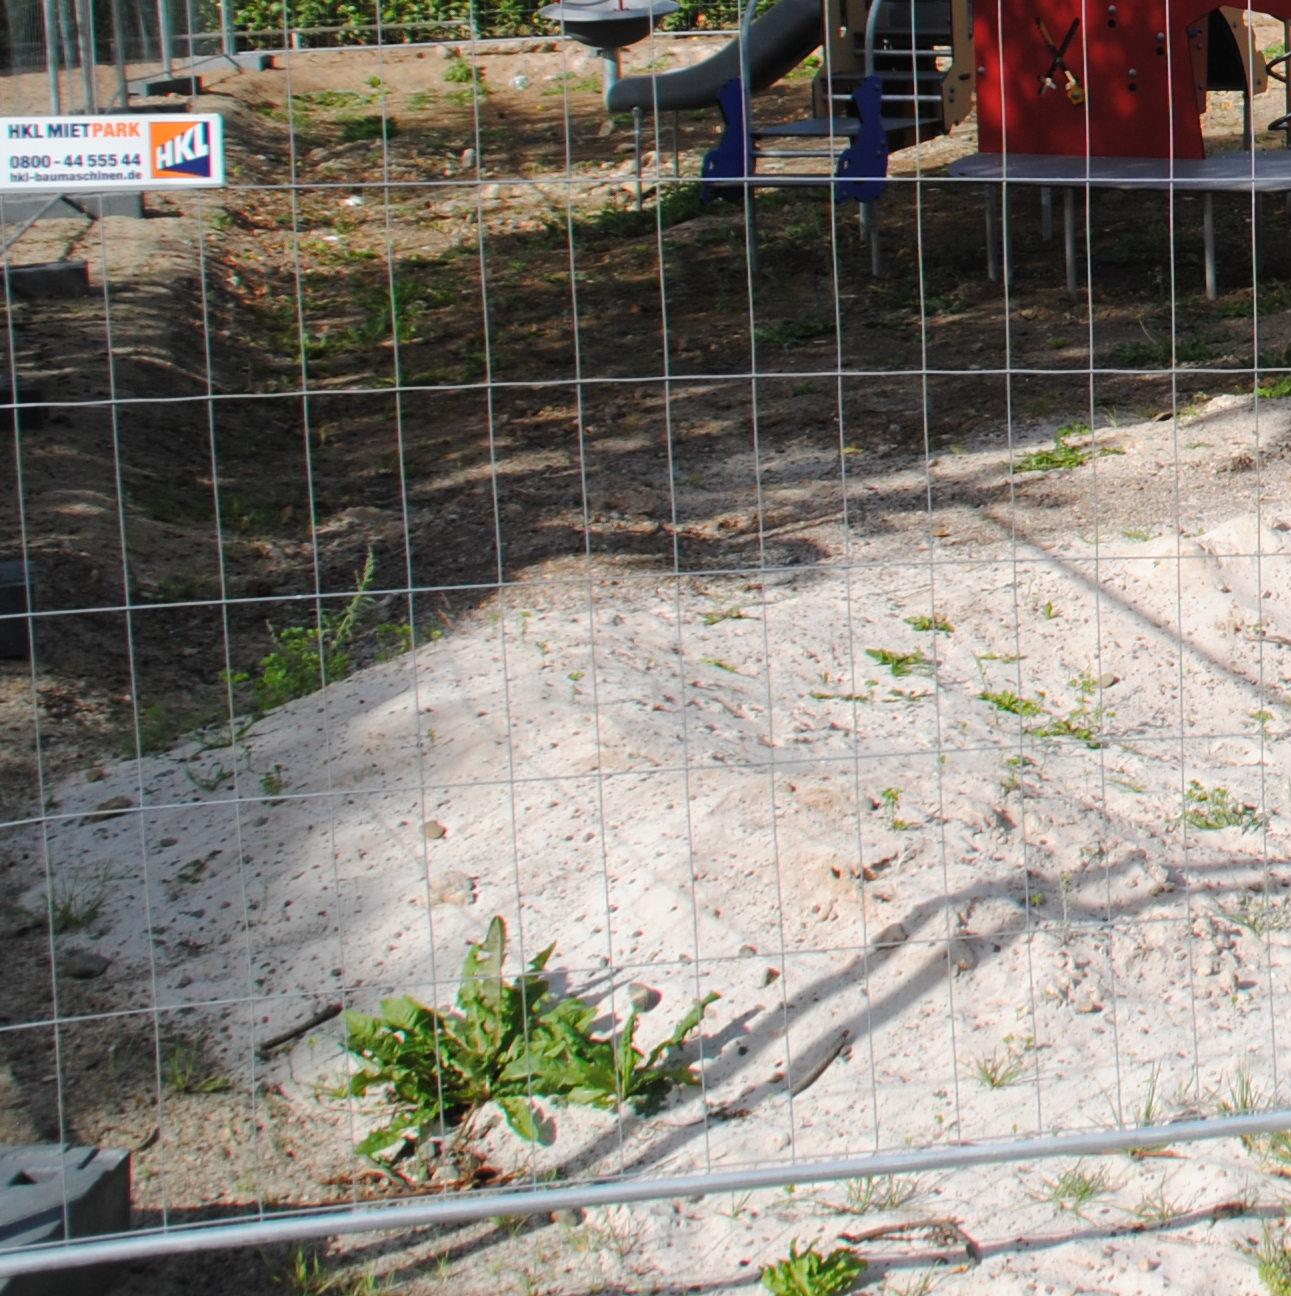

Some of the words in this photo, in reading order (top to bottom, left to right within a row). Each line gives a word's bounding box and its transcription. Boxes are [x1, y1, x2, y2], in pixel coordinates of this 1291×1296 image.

[8, 123, 43, 138] HKL
[47, 122, 140, 138] MIETPARK
[156, 122, 209, 170] HKL
[10, 155, 50, 169] 0800
[64, 155, 83, 167] 44
[87, 154, 117, 167] 555
[122, 154, 141, 166] 44
[10, 170, 142, 183] hkl-baumaschinen.de
